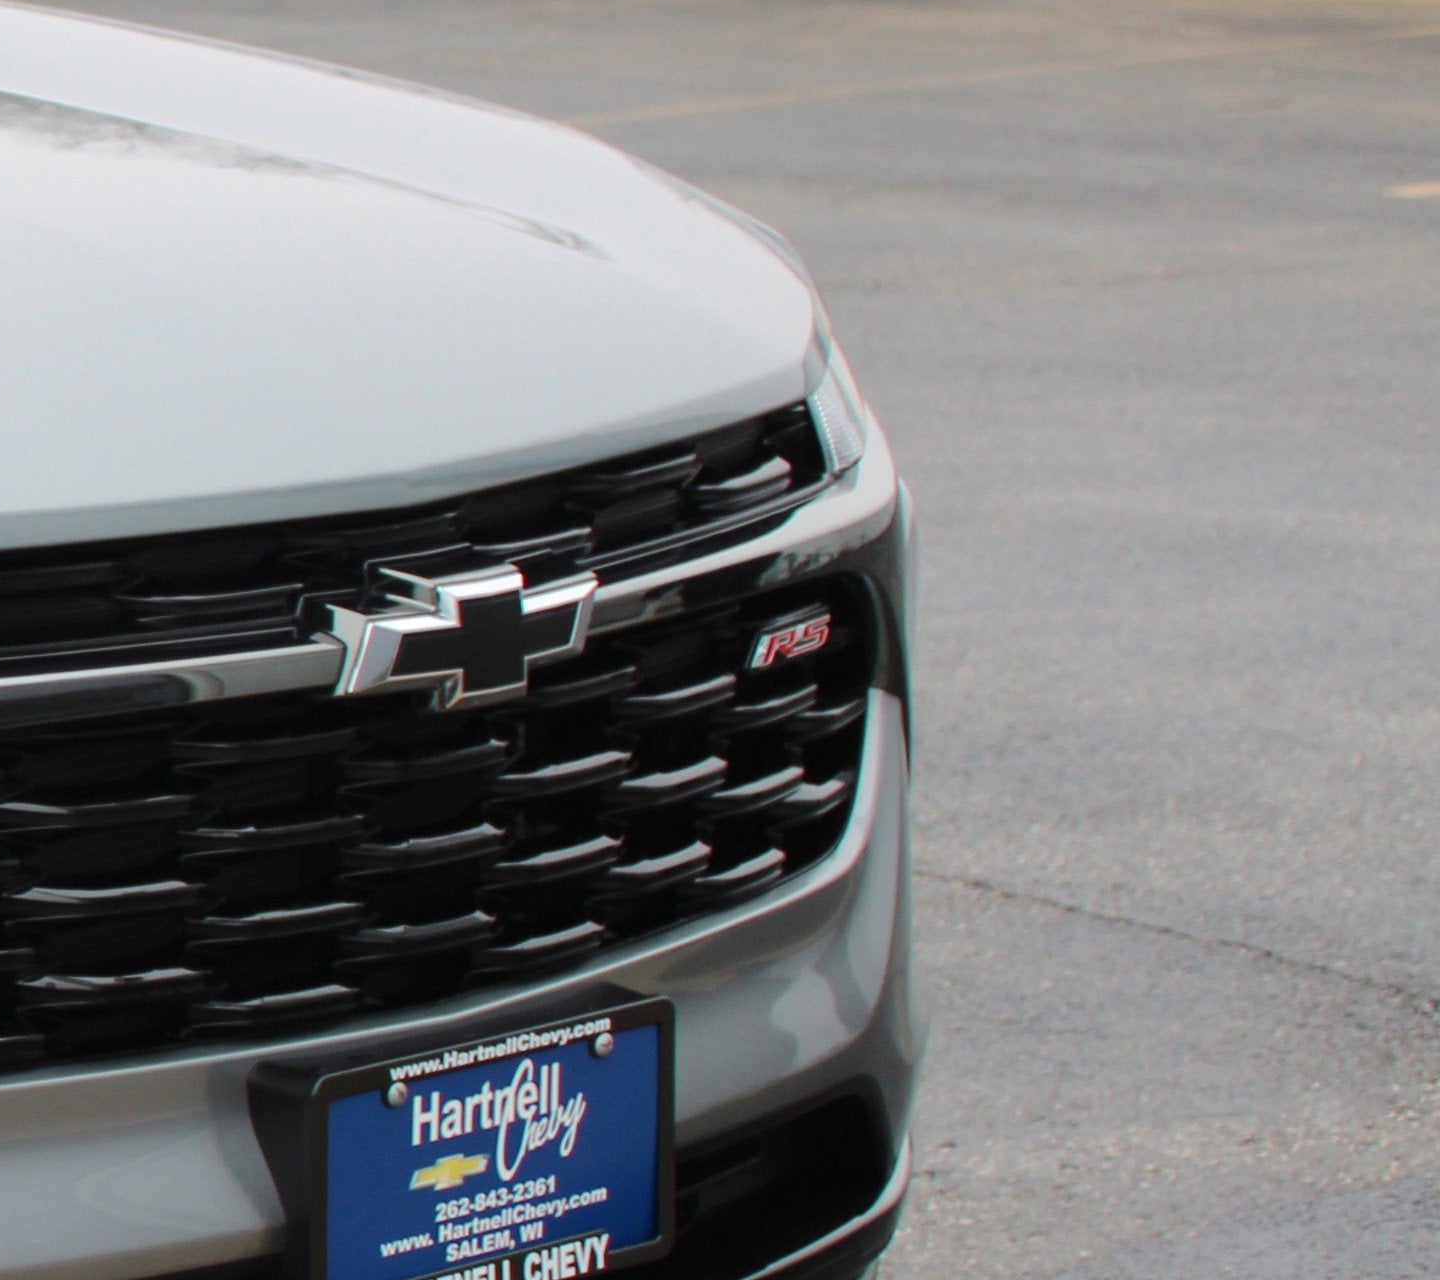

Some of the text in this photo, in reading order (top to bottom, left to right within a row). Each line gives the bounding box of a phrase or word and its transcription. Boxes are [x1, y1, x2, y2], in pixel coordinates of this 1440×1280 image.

[752, 613, 831, 668] RS
[389, 1018, 612, 1081] www.HartnellChevy.com
[411, 1062, 561, 1146] Hartnell
[496, 1057, 587, 1182] Chevy
[380, 1187, 608, 1258] www. HartnellChevy.com
[435, 1175, 557, 1223] 262-843-2361
[445, 1221, 544, 1263] SALEM, WI
